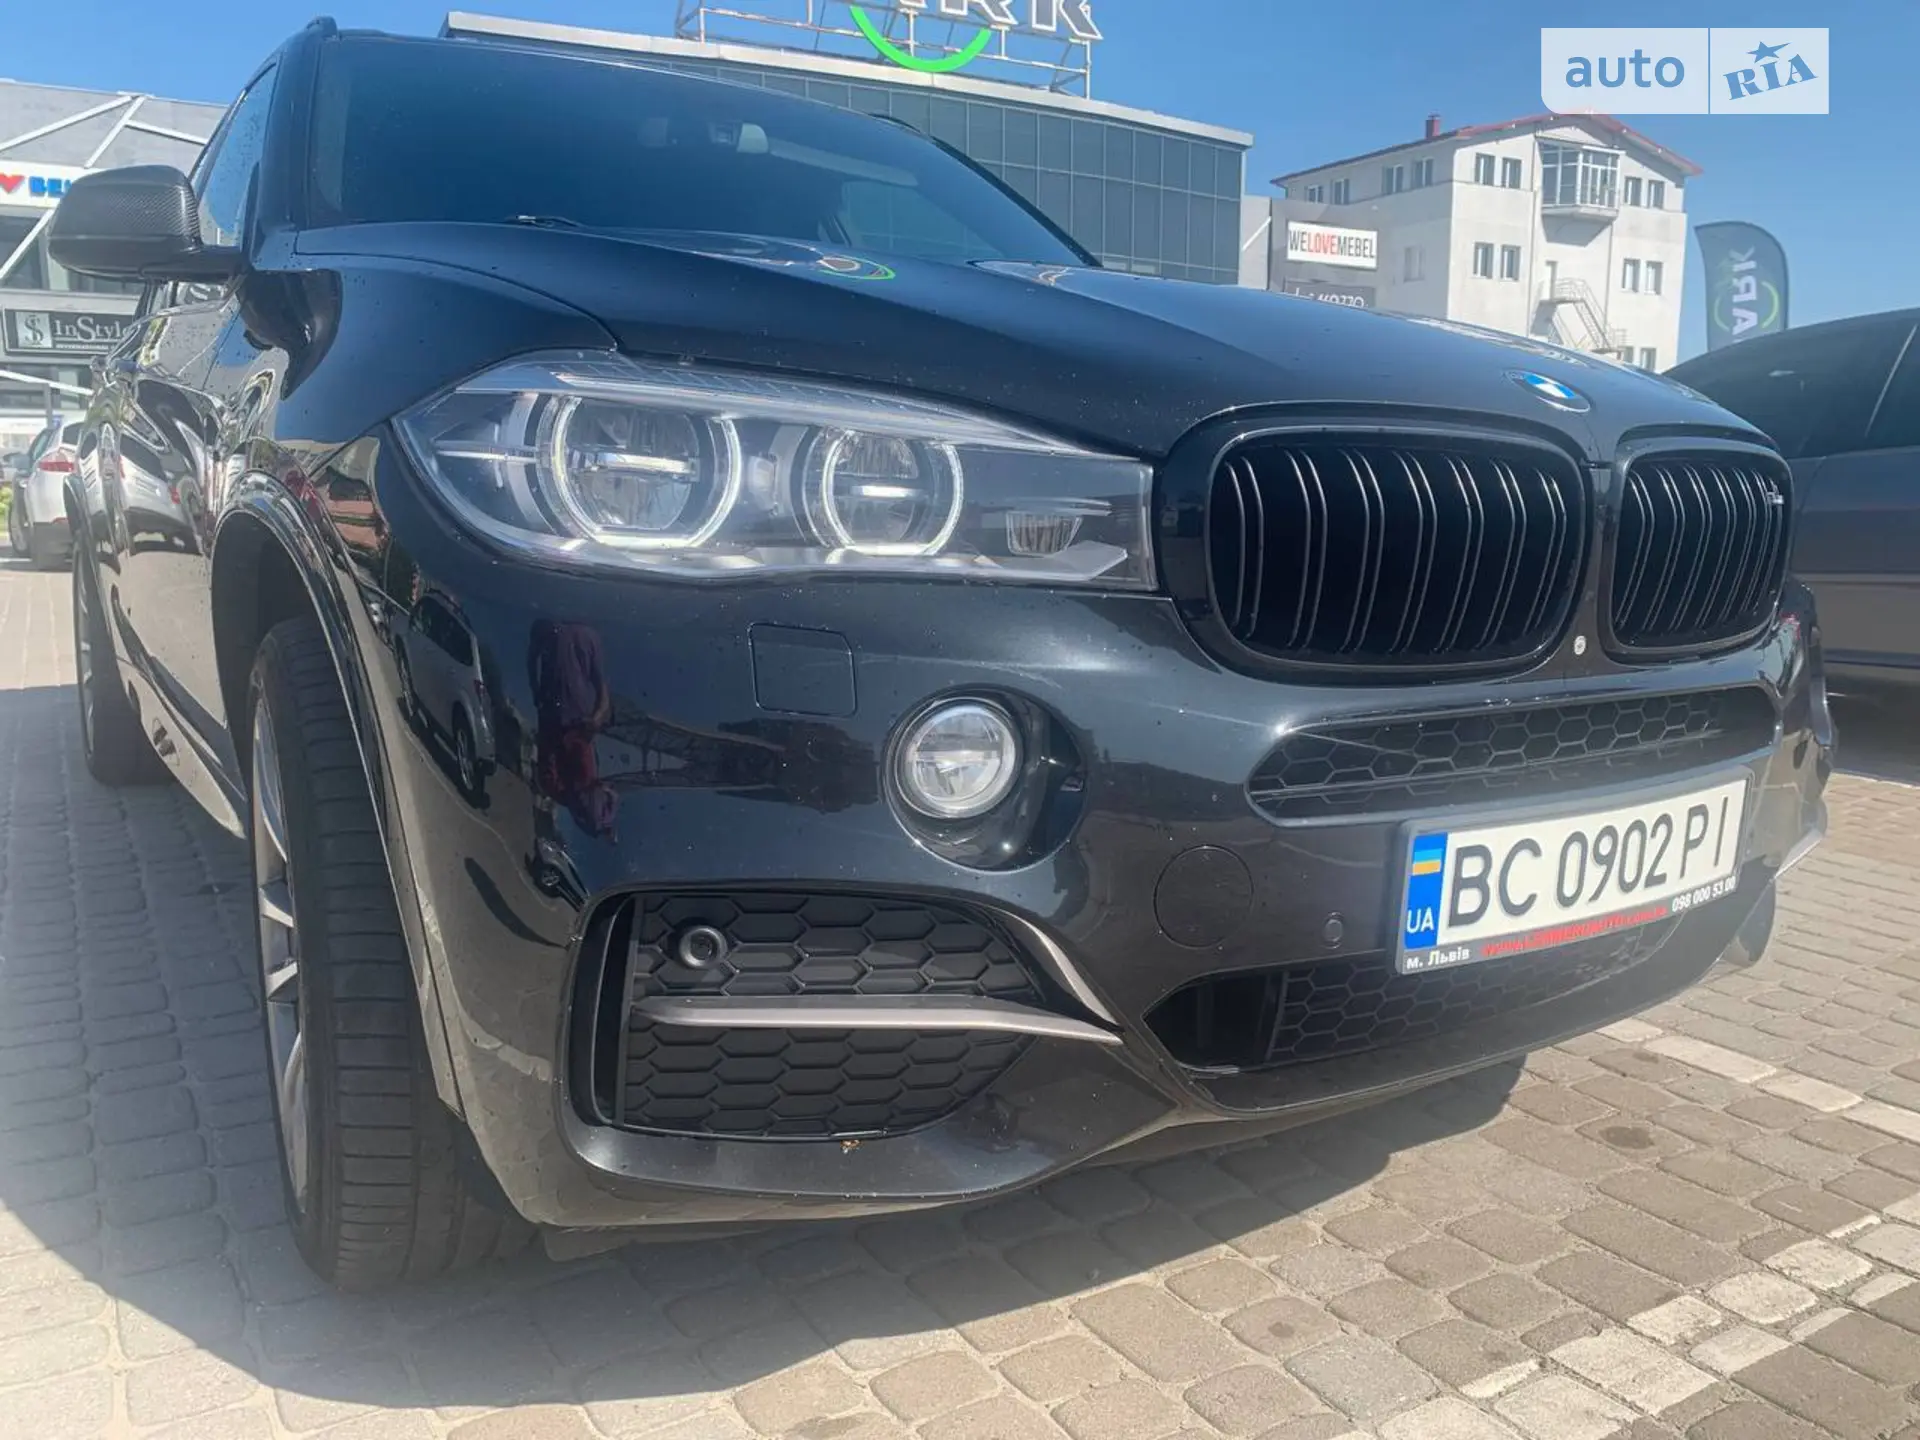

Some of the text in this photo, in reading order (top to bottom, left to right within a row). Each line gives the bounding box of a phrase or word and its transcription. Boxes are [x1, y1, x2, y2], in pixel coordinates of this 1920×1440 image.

[1448, 796, 1730, 928] BC 0902 PI
[1407, 907, 1434, 933] UA
[1427, 946, 1470, 966] Львів
